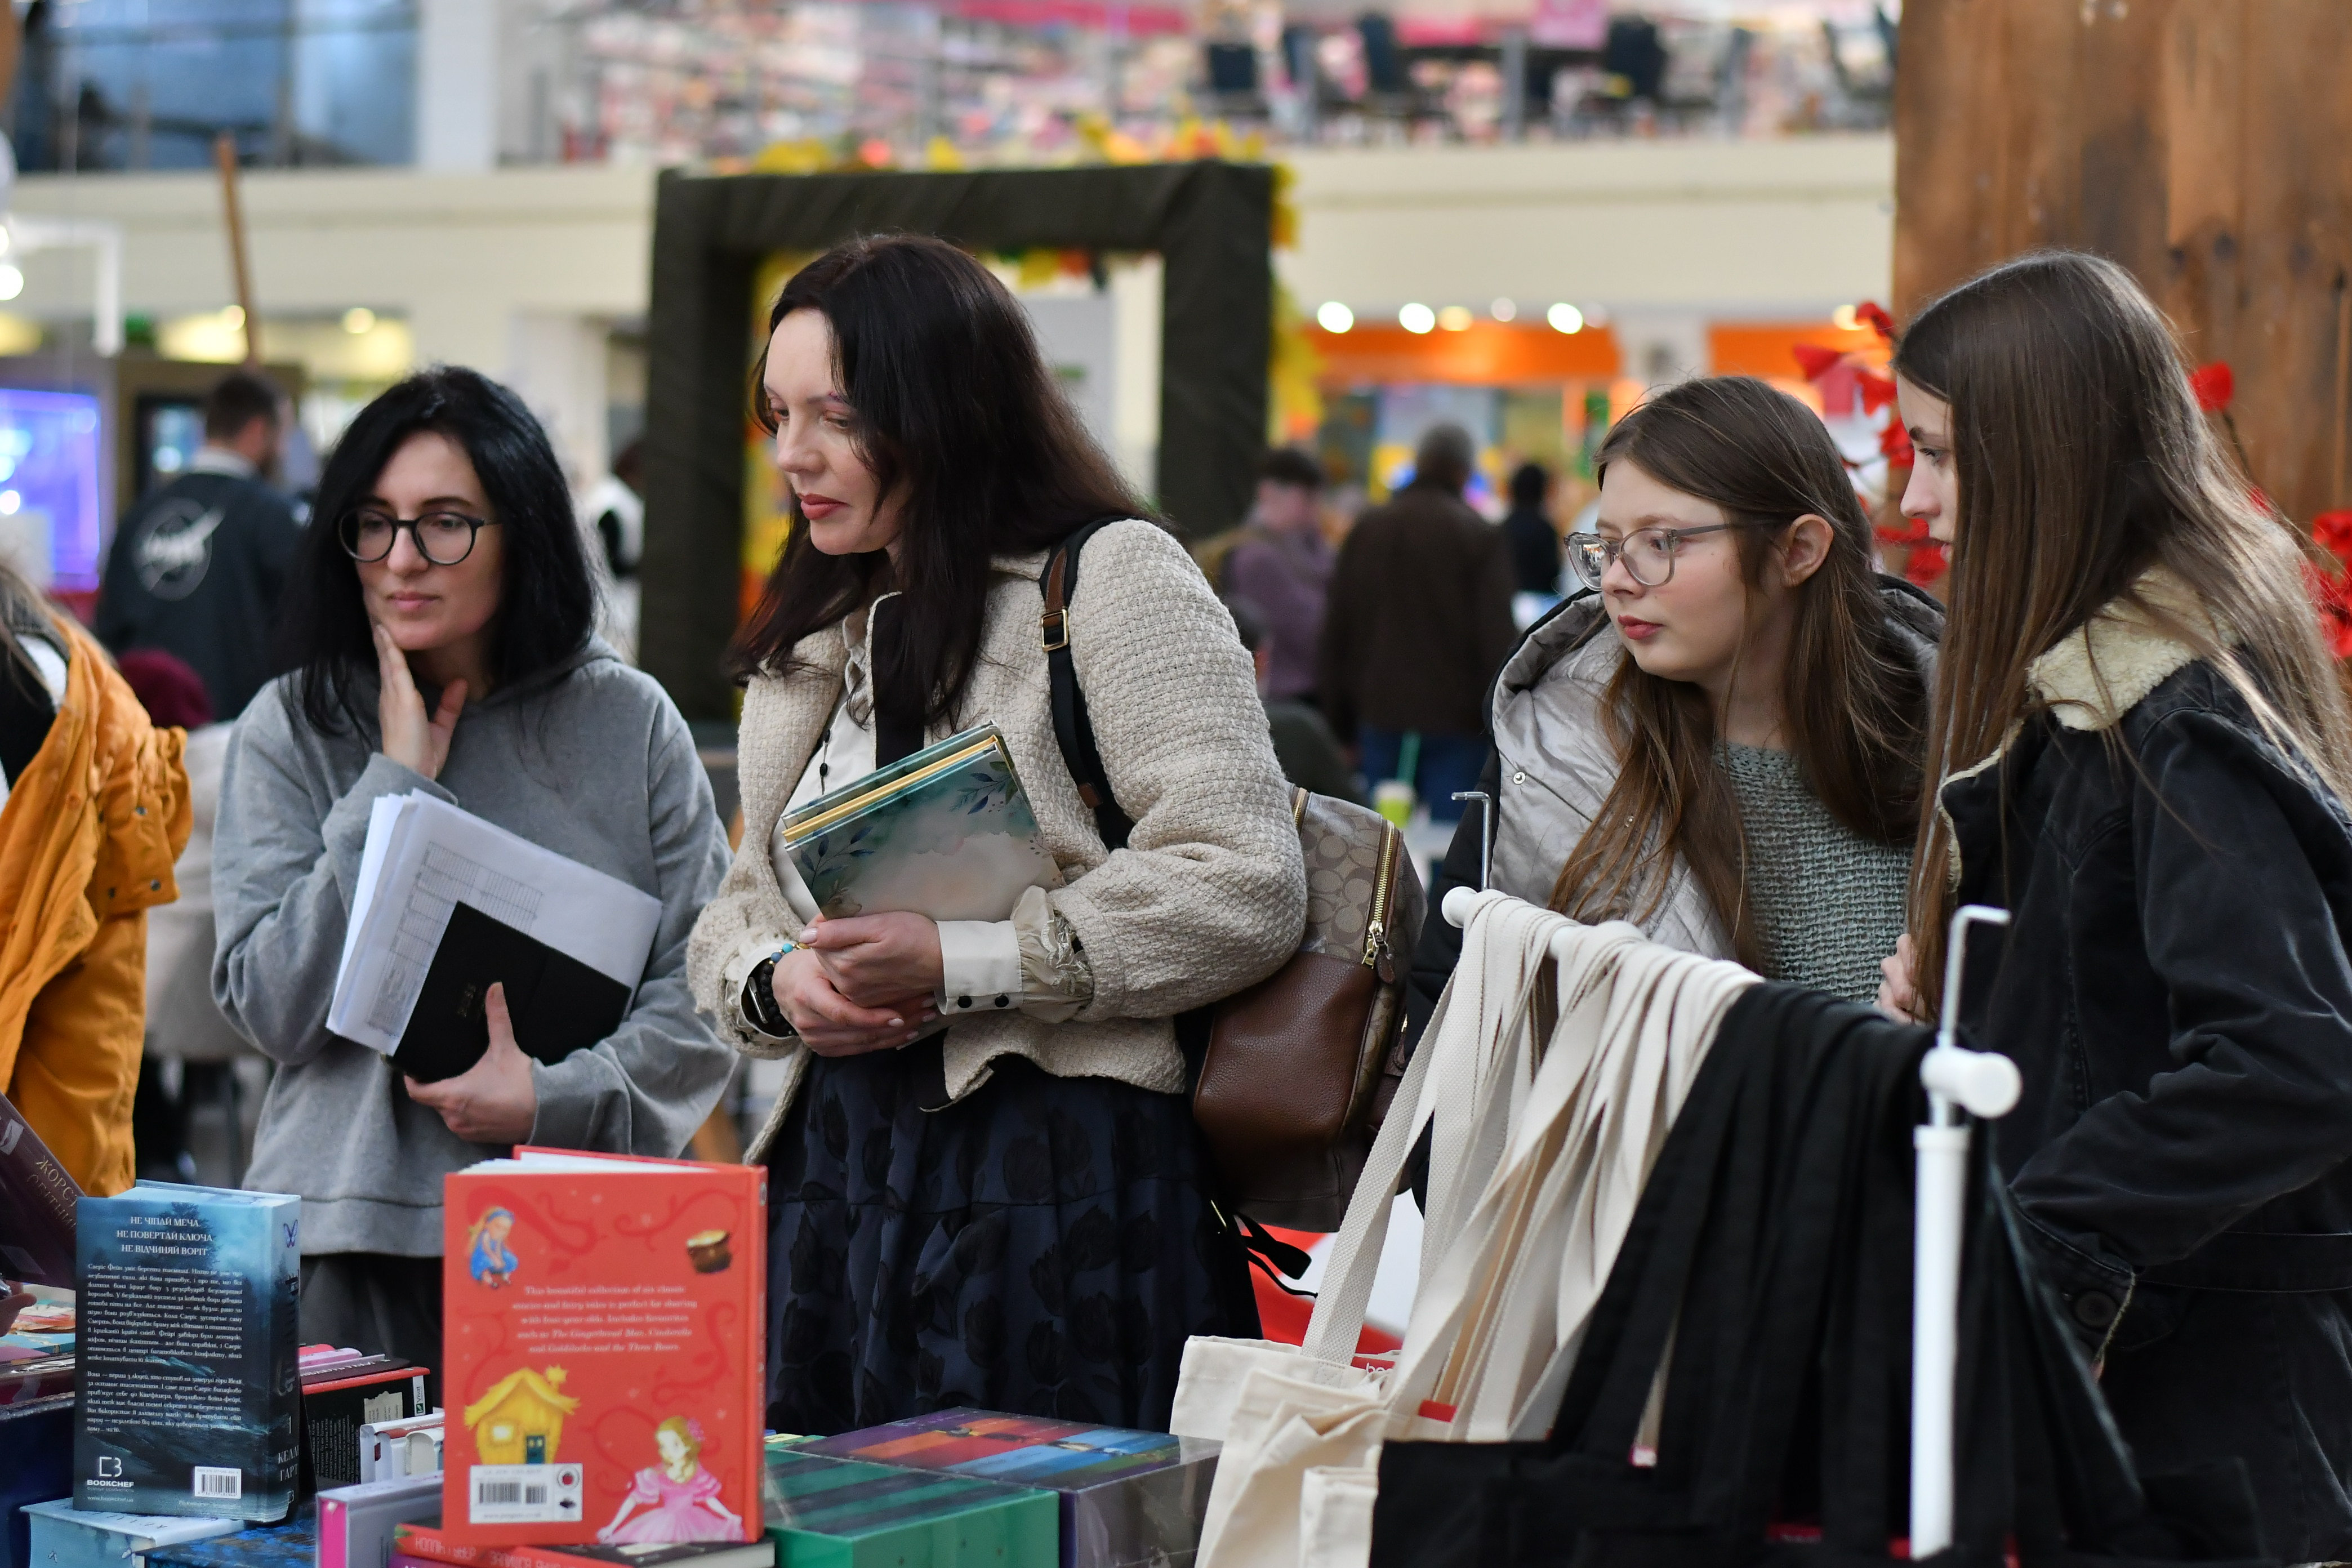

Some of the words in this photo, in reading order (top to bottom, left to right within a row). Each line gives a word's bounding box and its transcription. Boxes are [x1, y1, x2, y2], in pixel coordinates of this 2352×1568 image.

[144, 1217, 172, 1226] ЧІПАЙ
[130, 1231, 178, 1240] ПОВЕРТАЙ
[135, 1245, 180, 1254] ВІДЧИНЯЙ
[280, 1463, 299, 1481] ГАРТ
